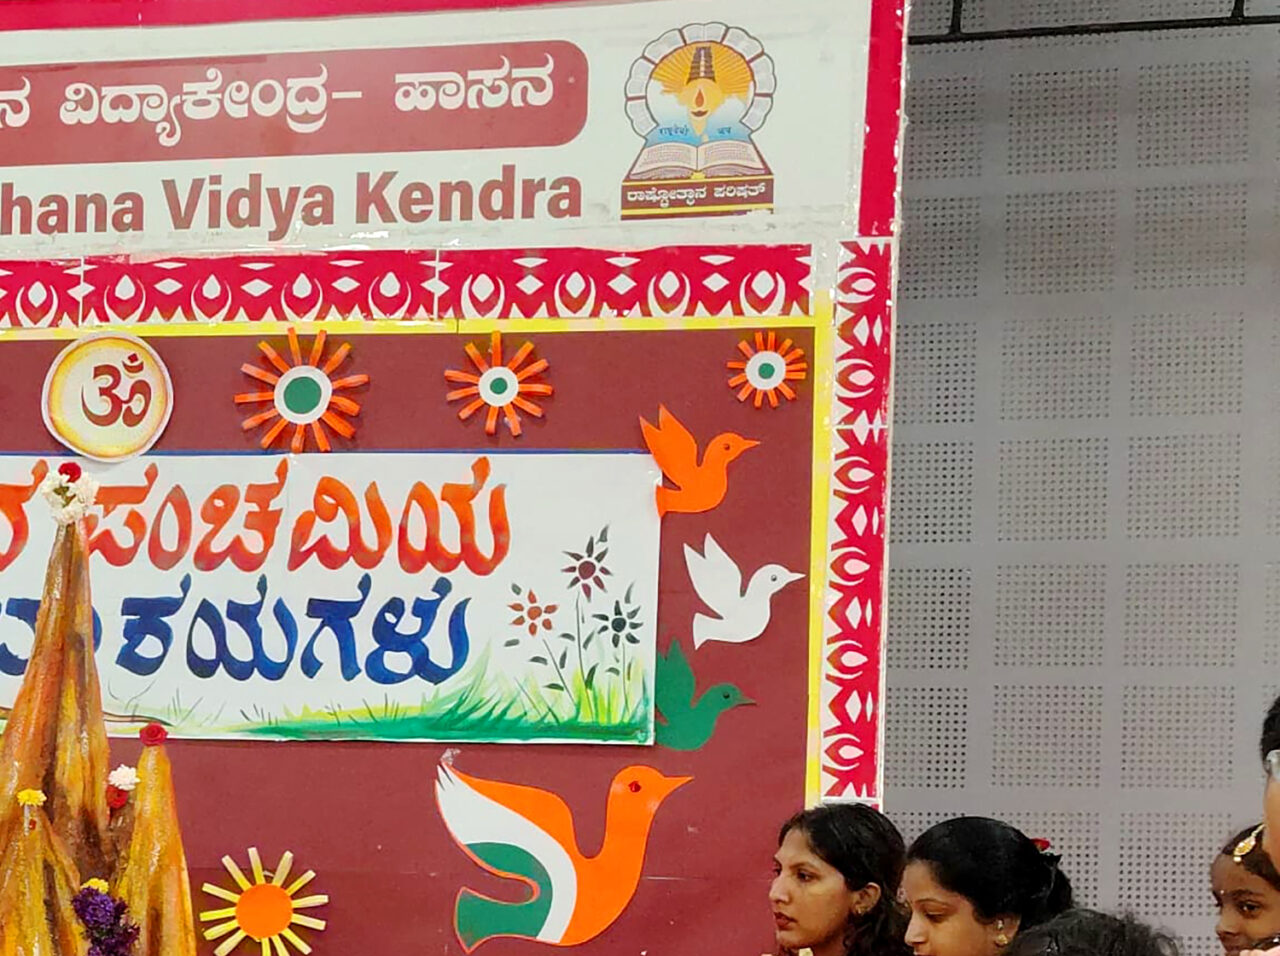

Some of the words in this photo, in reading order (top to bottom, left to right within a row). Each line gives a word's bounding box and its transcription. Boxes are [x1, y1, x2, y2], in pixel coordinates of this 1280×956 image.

[395, 53, 554, 111] ಹಾಸನ
[161, 173, 335, 242] Vidya
[355, 164, 583, 225] Kendra
